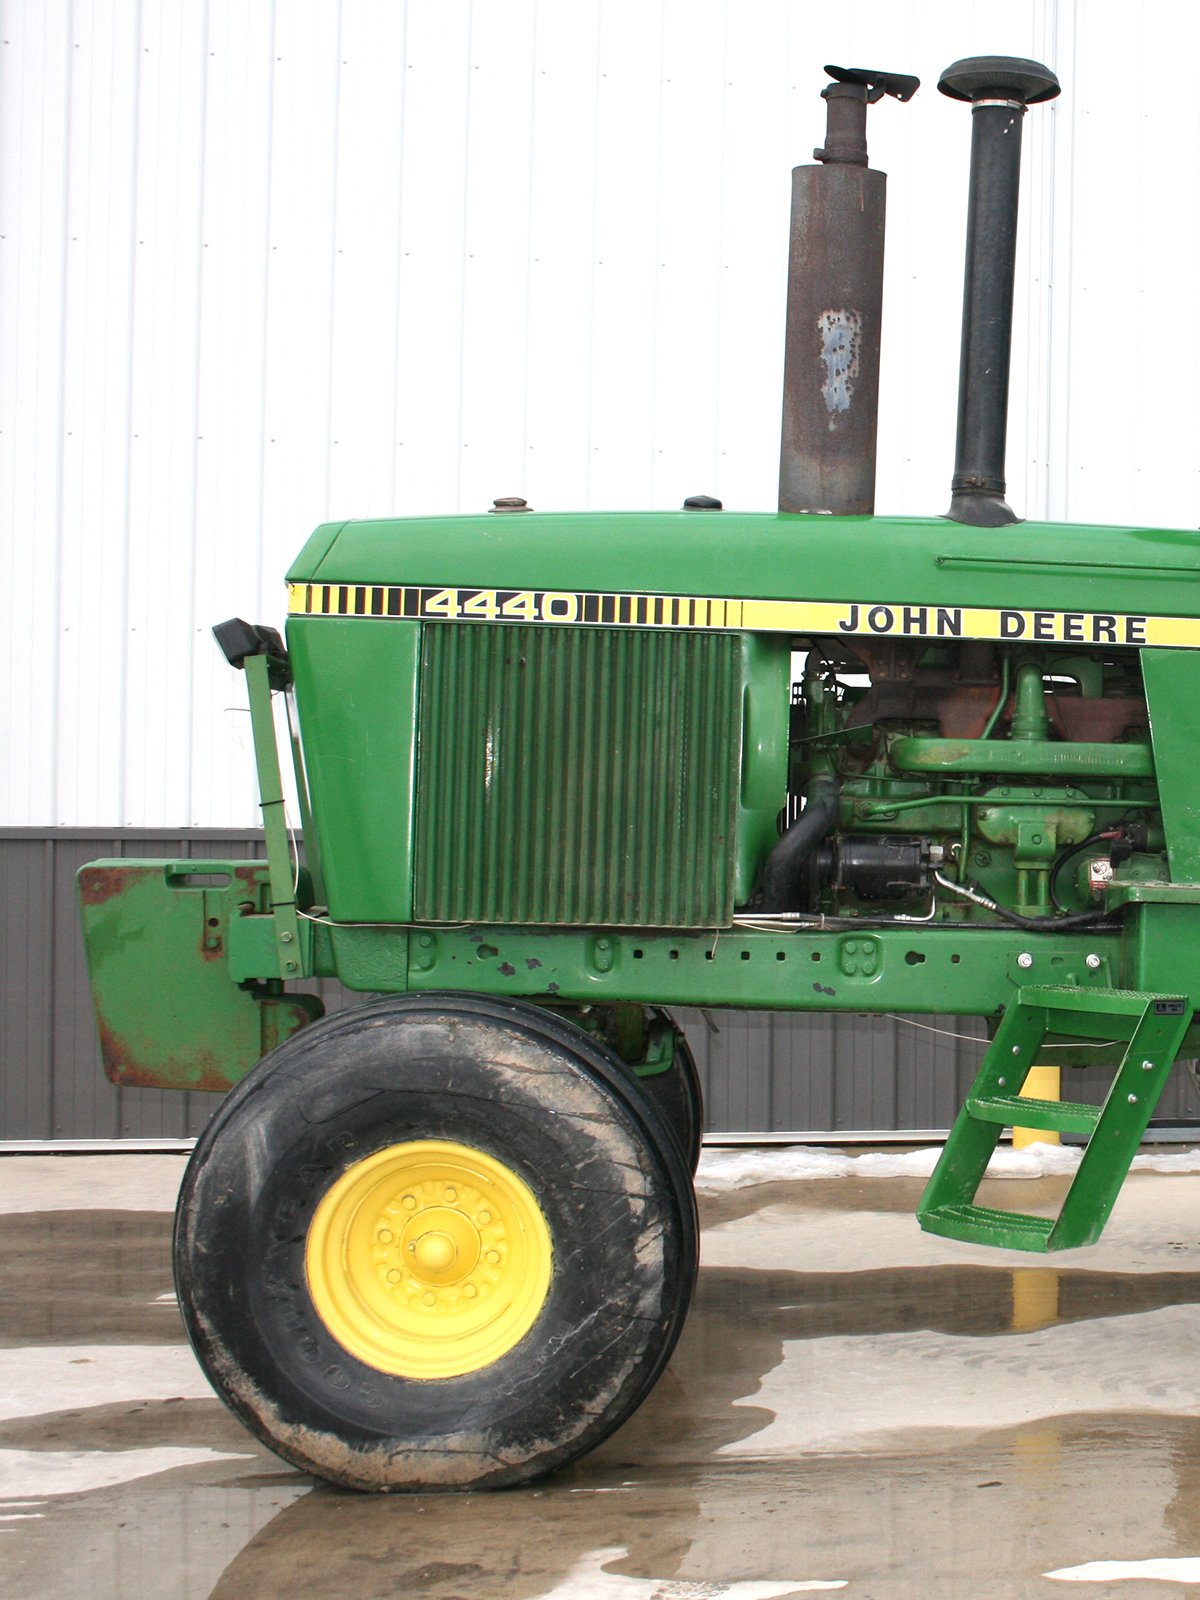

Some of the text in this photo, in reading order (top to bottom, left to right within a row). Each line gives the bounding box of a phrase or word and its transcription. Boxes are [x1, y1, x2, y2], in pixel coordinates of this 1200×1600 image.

[425, 589, 578, 622] 4440
[839, 604, 1147, 644] JOHN DEERE
